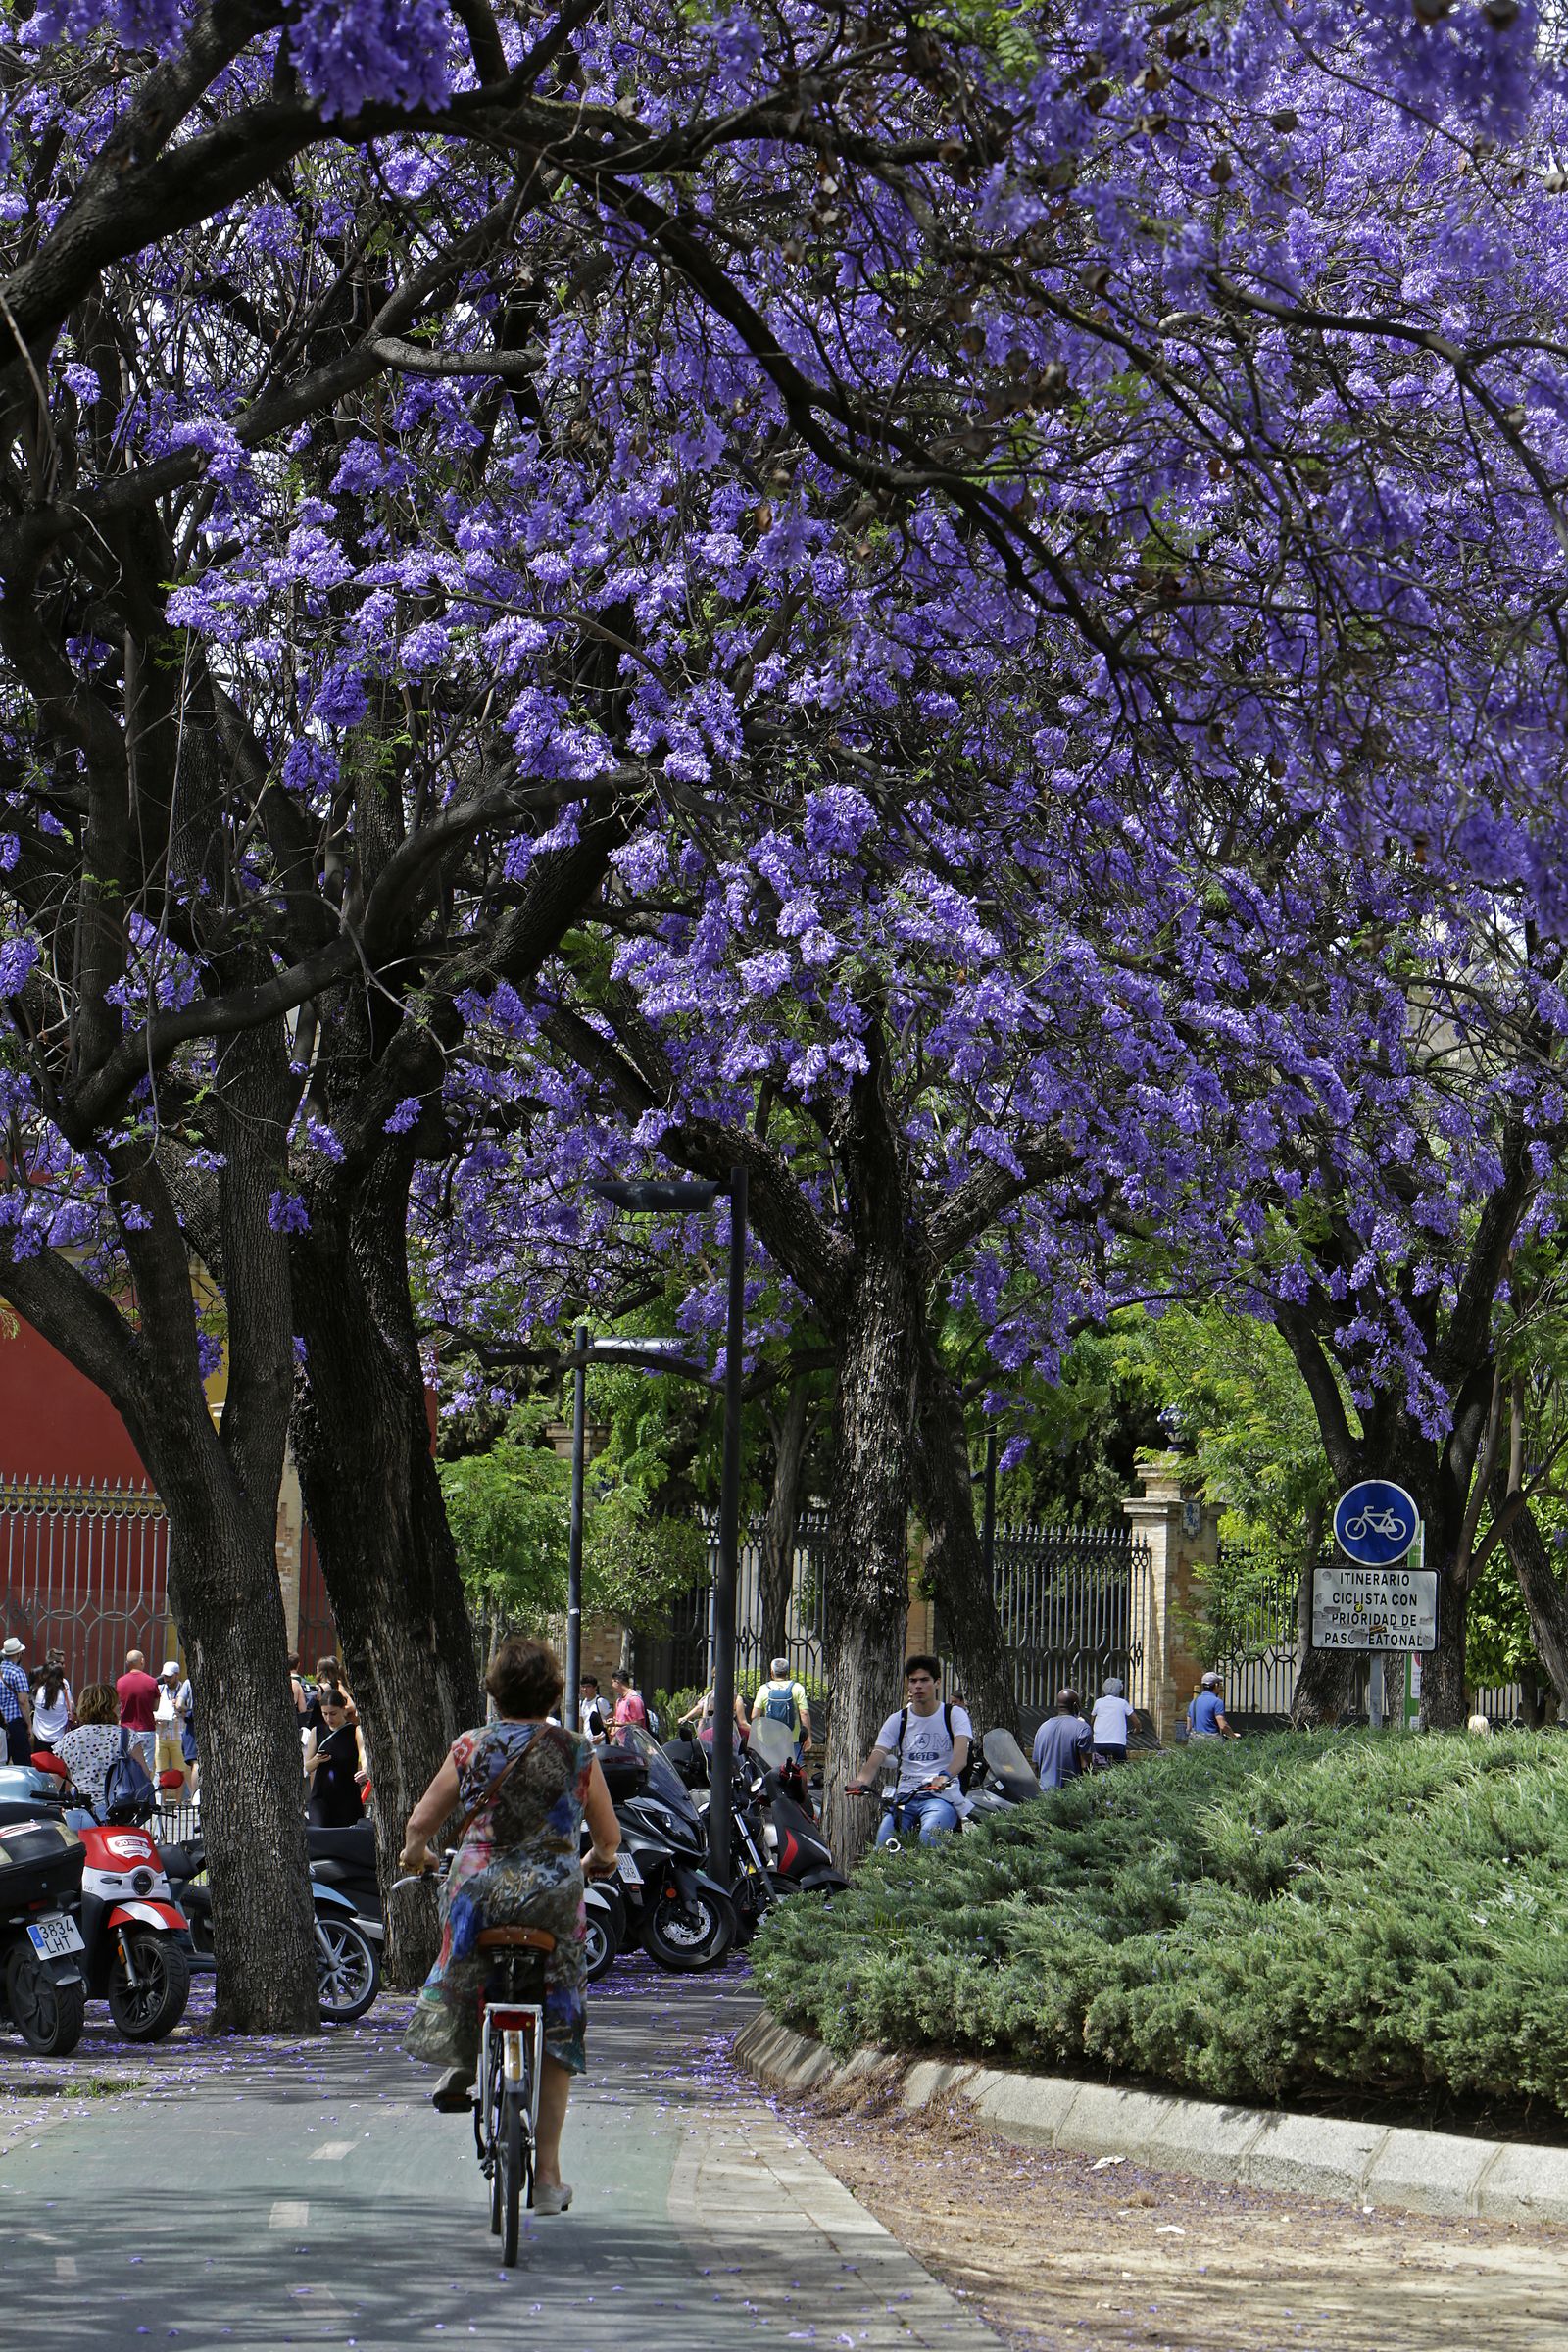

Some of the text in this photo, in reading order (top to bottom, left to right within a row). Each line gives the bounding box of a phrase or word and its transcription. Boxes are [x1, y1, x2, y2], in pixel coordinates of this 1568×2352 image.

[1340, 1572, 1410, 1586] ITINERARIO
[1332, 1592, 1417, 1606] CICLISTA CON
[1332, 1612, 1417, 1627] PRIORIDAD DE
[1360, 1633, 1423, 1646] EATONAL
[38, 1919, 74, 1939] 3834
[44, 1936, 71, 1954] LHT
